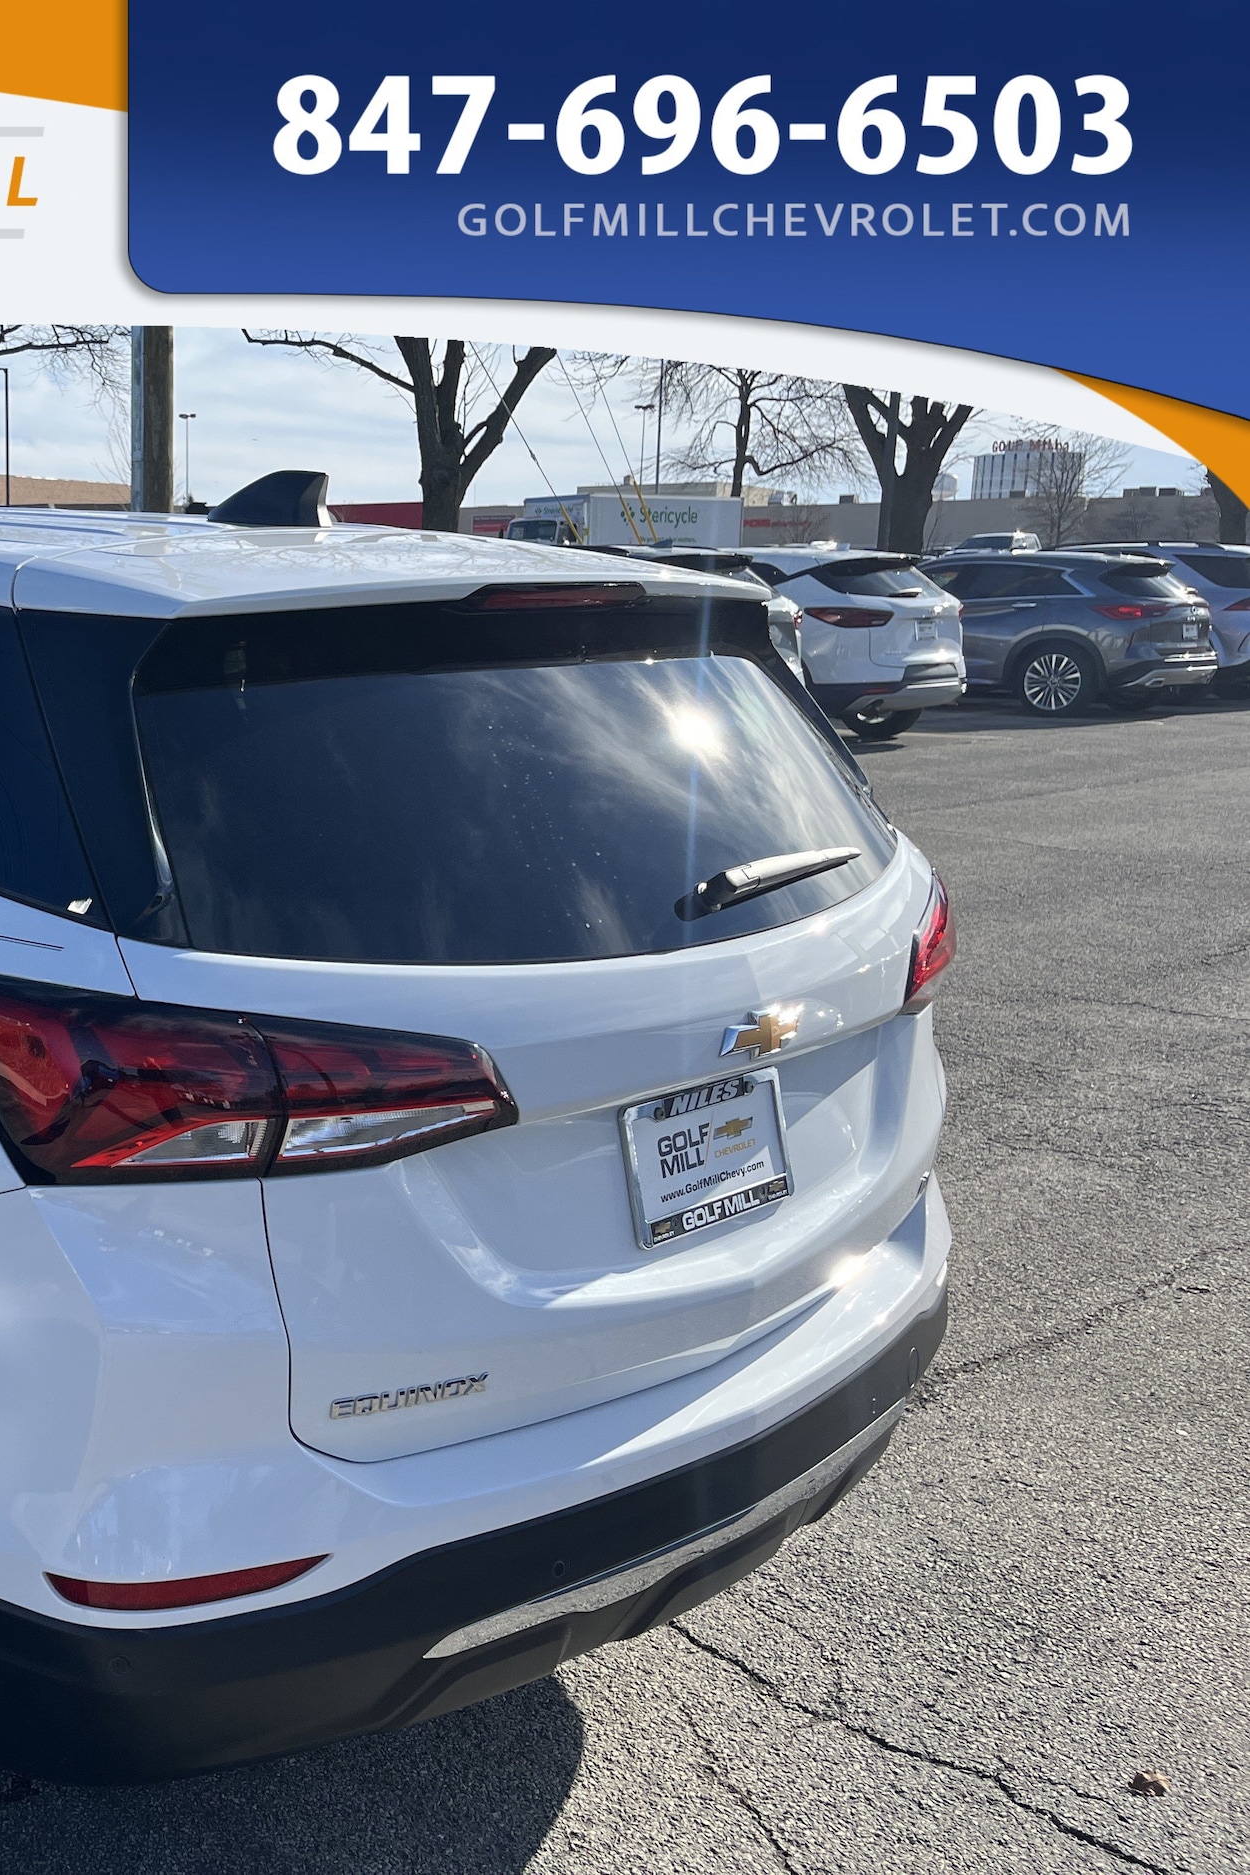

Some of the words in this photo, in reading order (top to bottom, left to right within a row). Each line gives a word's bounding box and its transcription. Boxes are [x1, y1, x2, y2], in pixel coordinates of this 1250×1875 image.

[669, 1080, 740, 1118] NILES
[657, 1122, 710, 1158] GOLF
[714, 1137, 757, 1160] CHEVROLET
[660, 1145, 706, 1179] MILL
[660, 1160, 765, 1203] www.GolfMillChevy.com
[682, 1202, 724, 1232] GOLF
[724, 1190, 761, 1217] MILL
[329, 1371, 490, 1420] EQUINOX
